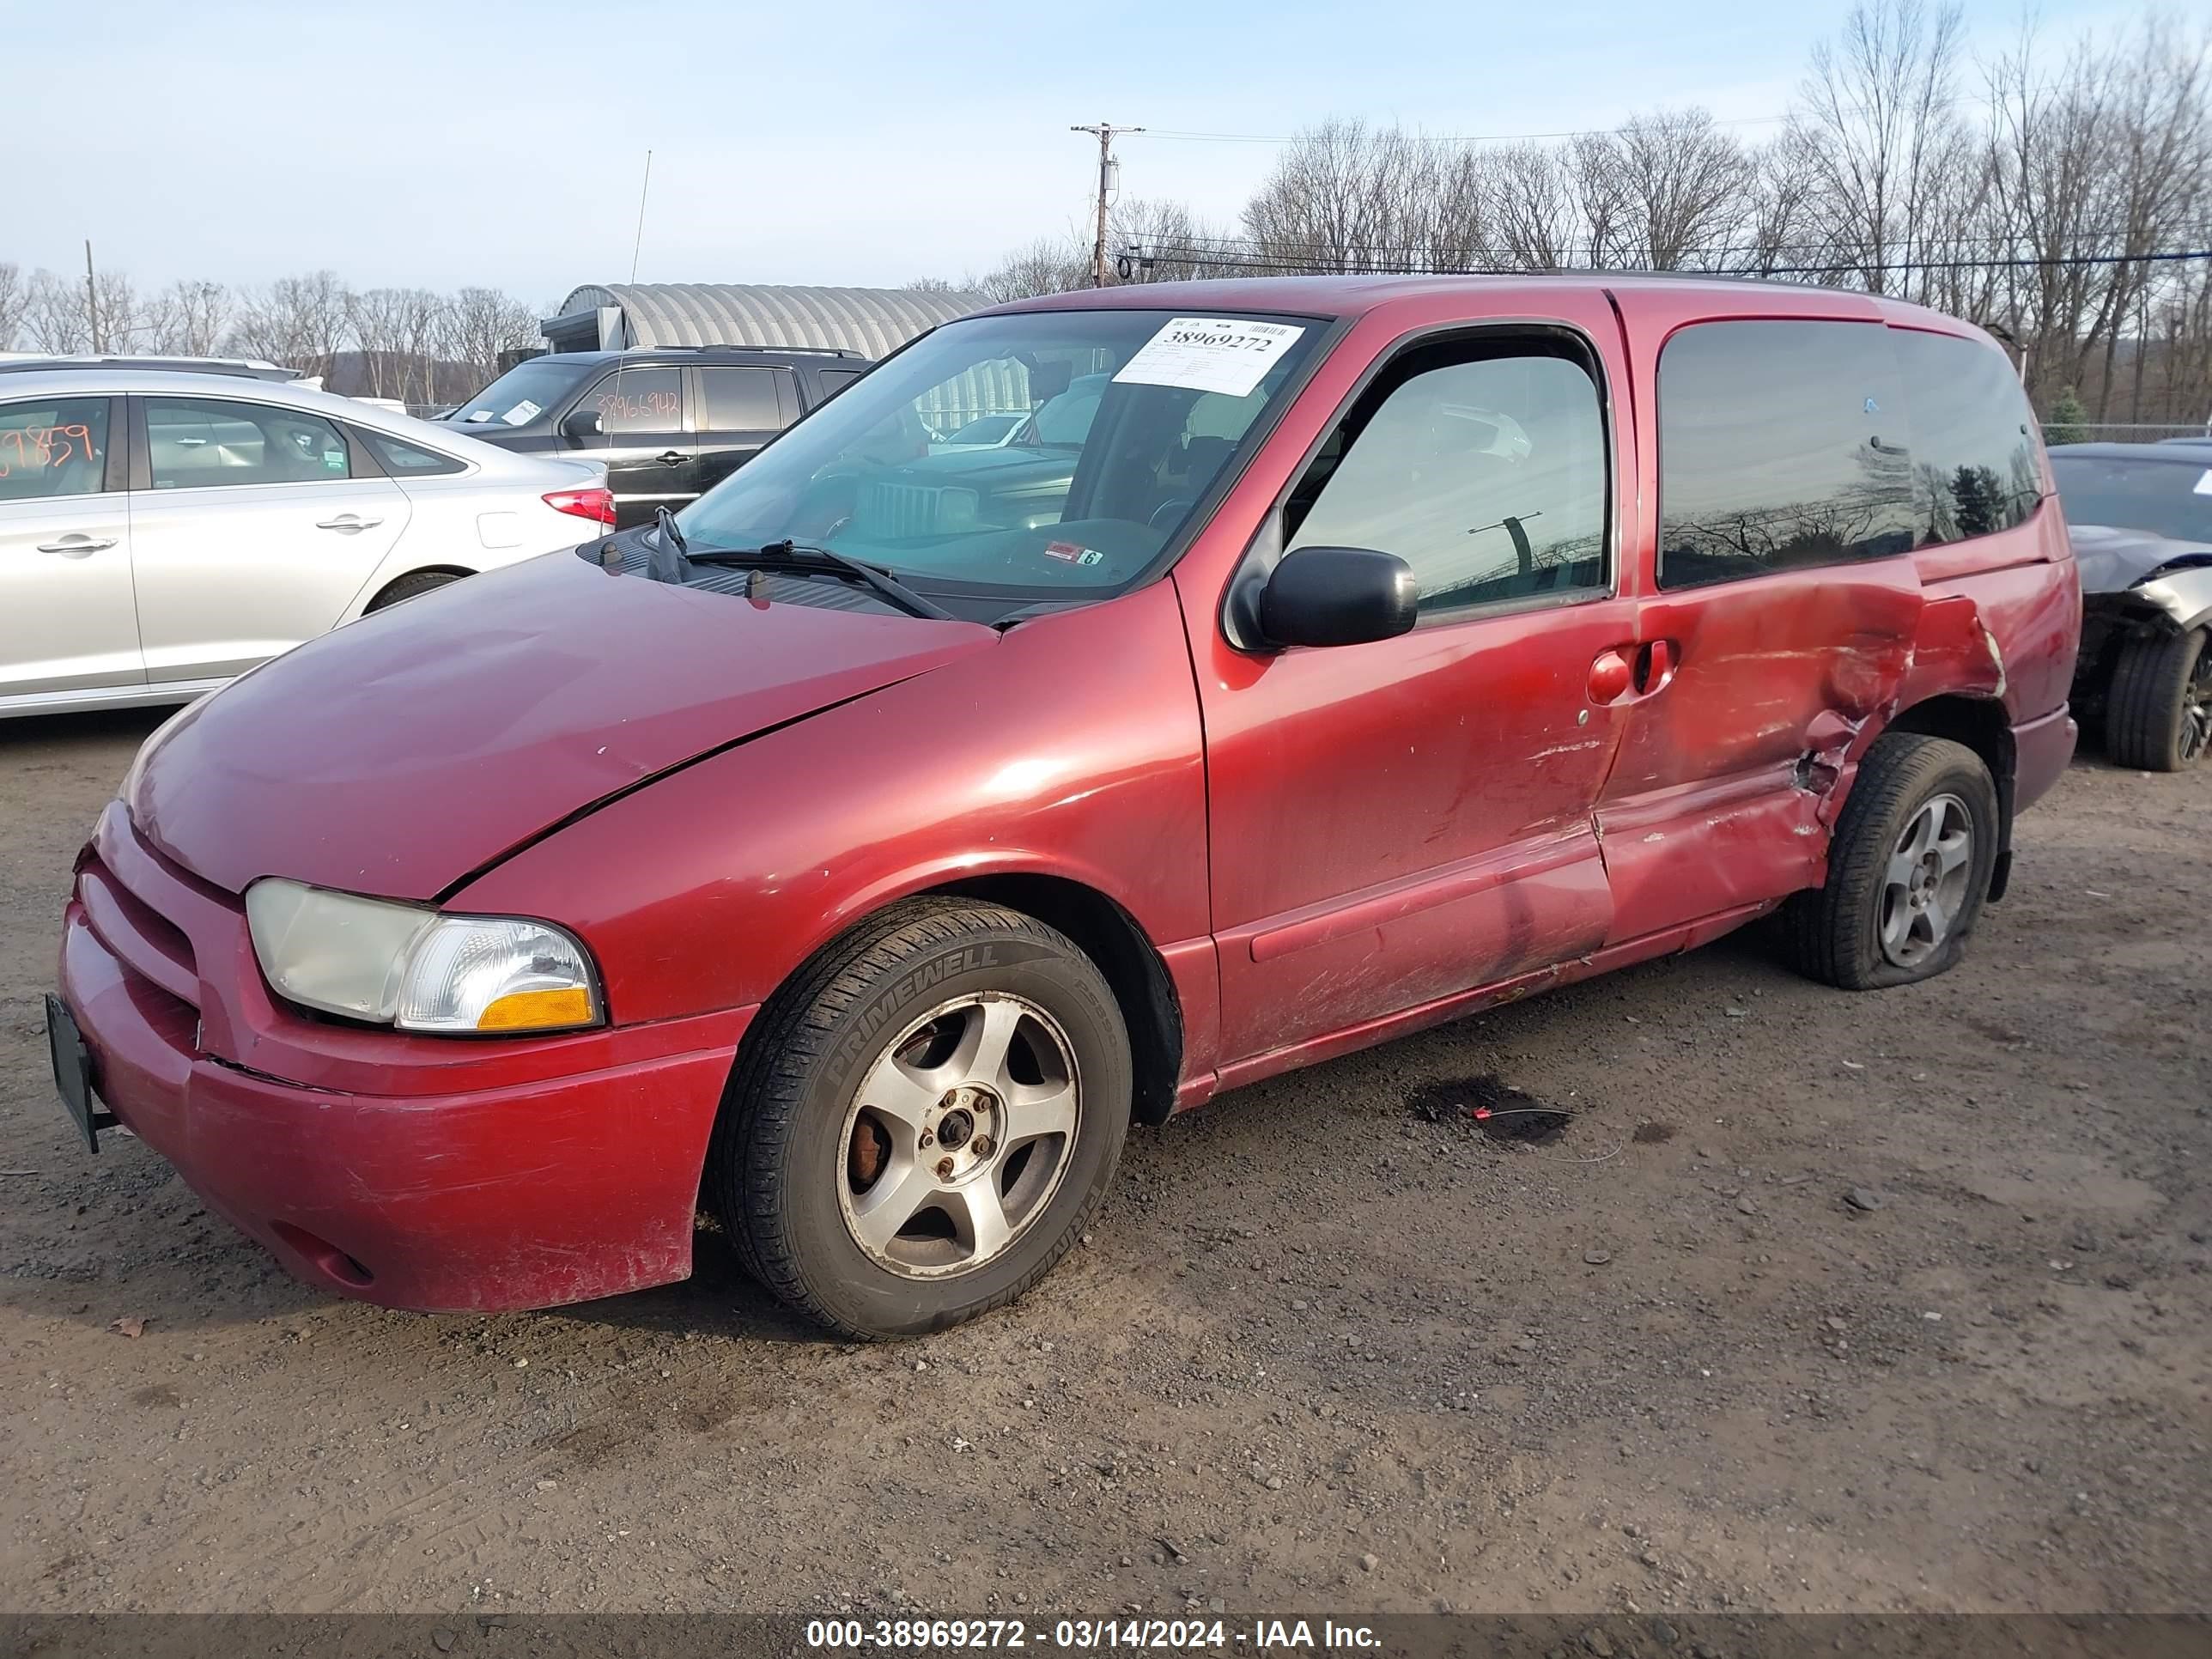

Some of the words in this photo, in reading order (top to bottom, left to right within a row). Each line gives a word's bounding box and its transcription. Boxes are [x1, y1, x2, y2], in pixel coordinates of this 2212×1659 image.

[1164, 331, 1273, 352] 38969272
[1084, 552, 1097, 564] 6
[824, 945, 999, 1088] PRIMEWELL
